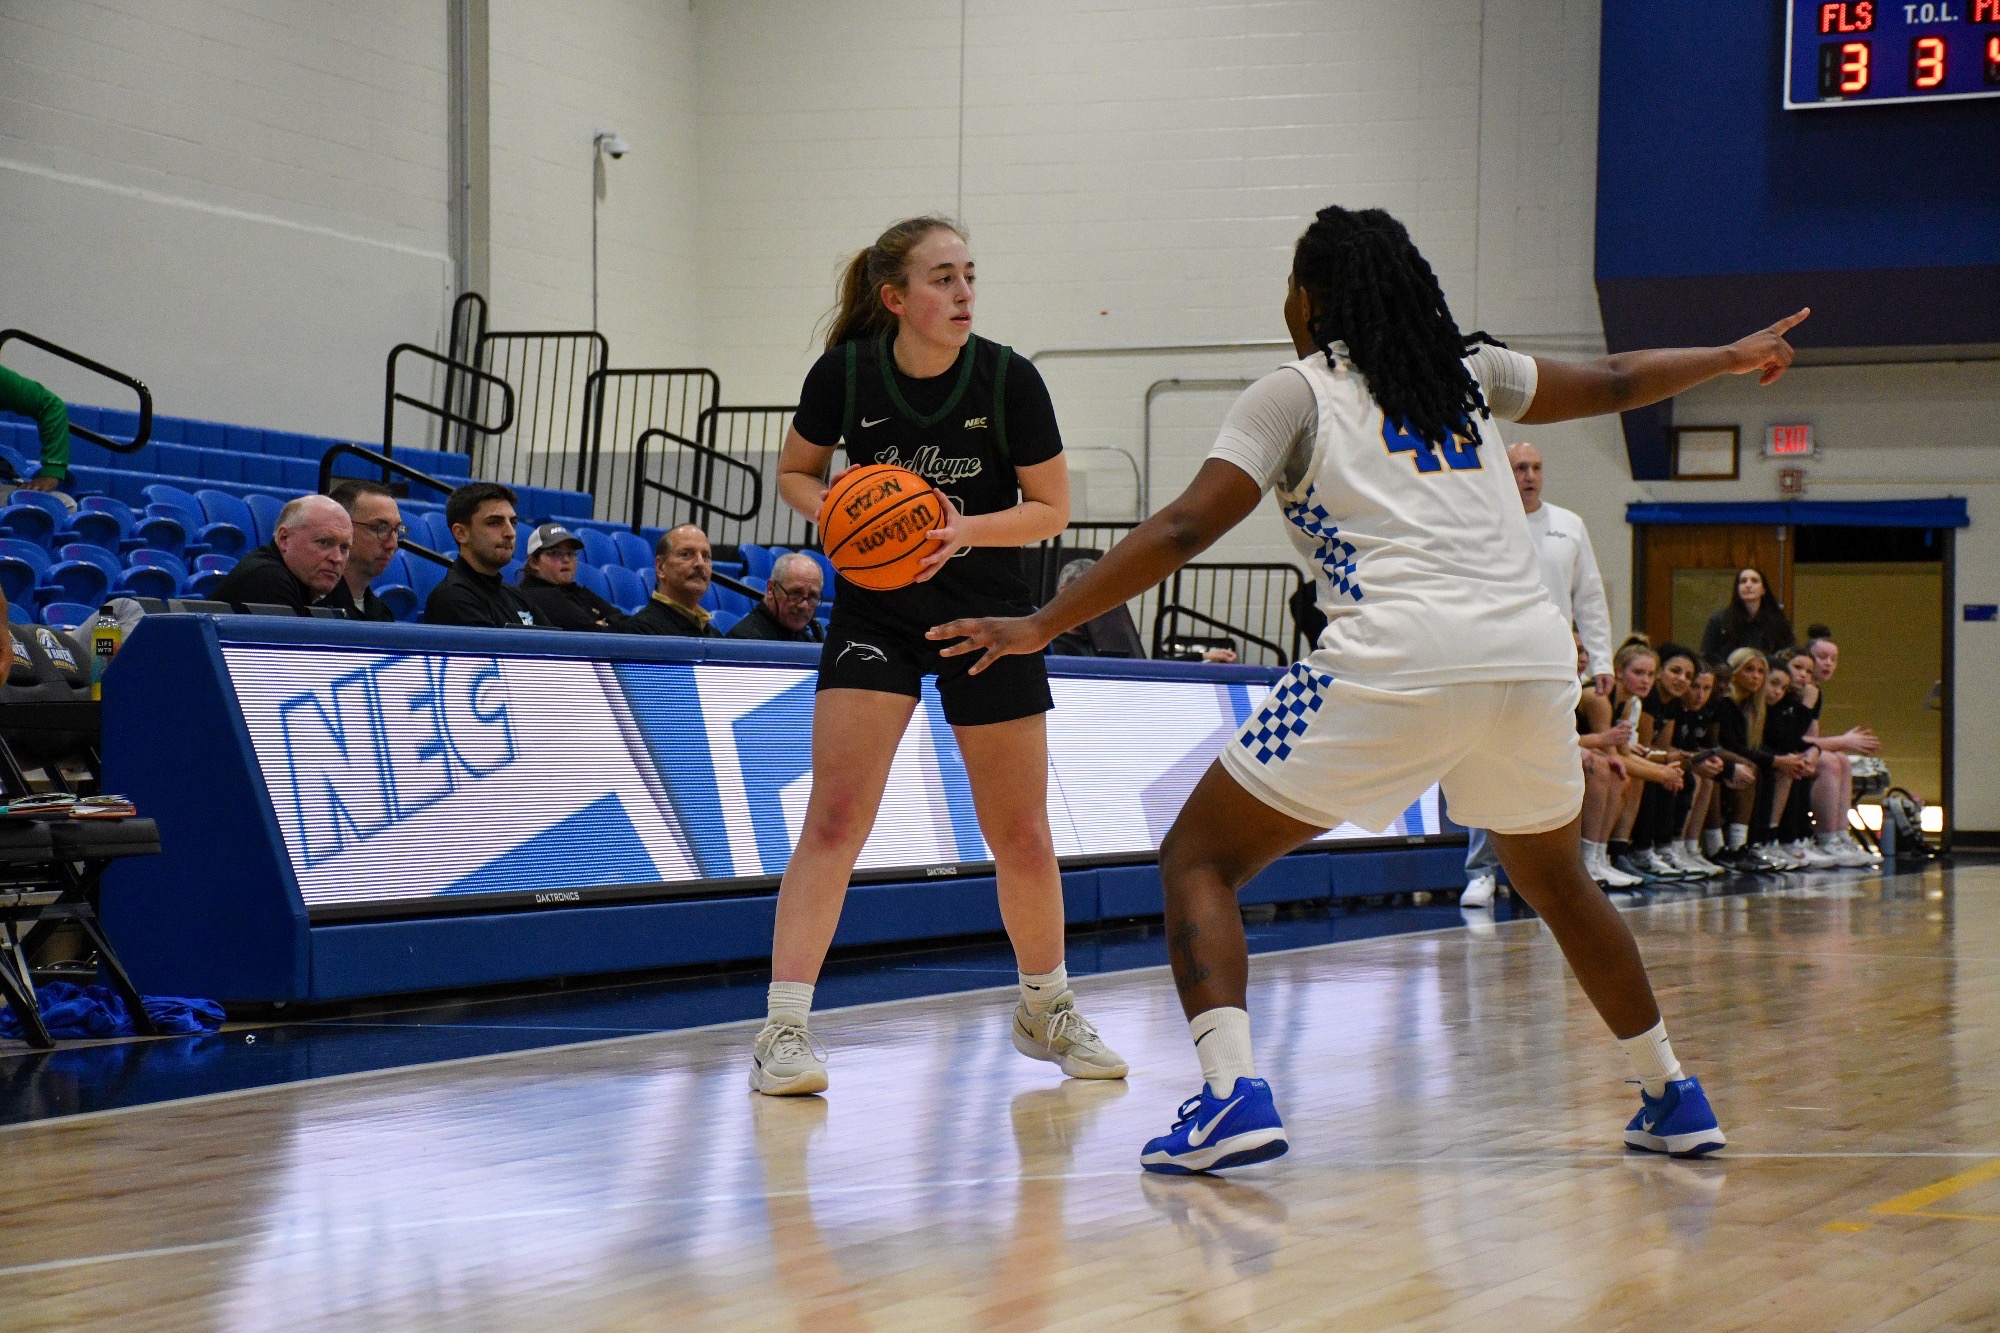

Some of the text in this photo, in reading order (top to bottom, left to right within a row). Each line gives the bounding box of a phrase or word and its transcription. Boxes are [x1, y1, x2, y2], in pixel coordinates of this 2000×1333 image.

[1821, 2, 1873, 33] FLS
[1904, 3, 1959, 24] T.O.L.
[1841, 43, 1869, 92] 3
[1916, 38, 1944, 87] 3
[964, 416, 987, 429] NEC
[1774, 425, 1808, 453] EXIT
[903, 445, 983, 484] Moyne
[852, 503, 935, 555] Wilson
[279, 655, 516, 872] NEC
[535, 891, 580, 903] DAKTRONICS
